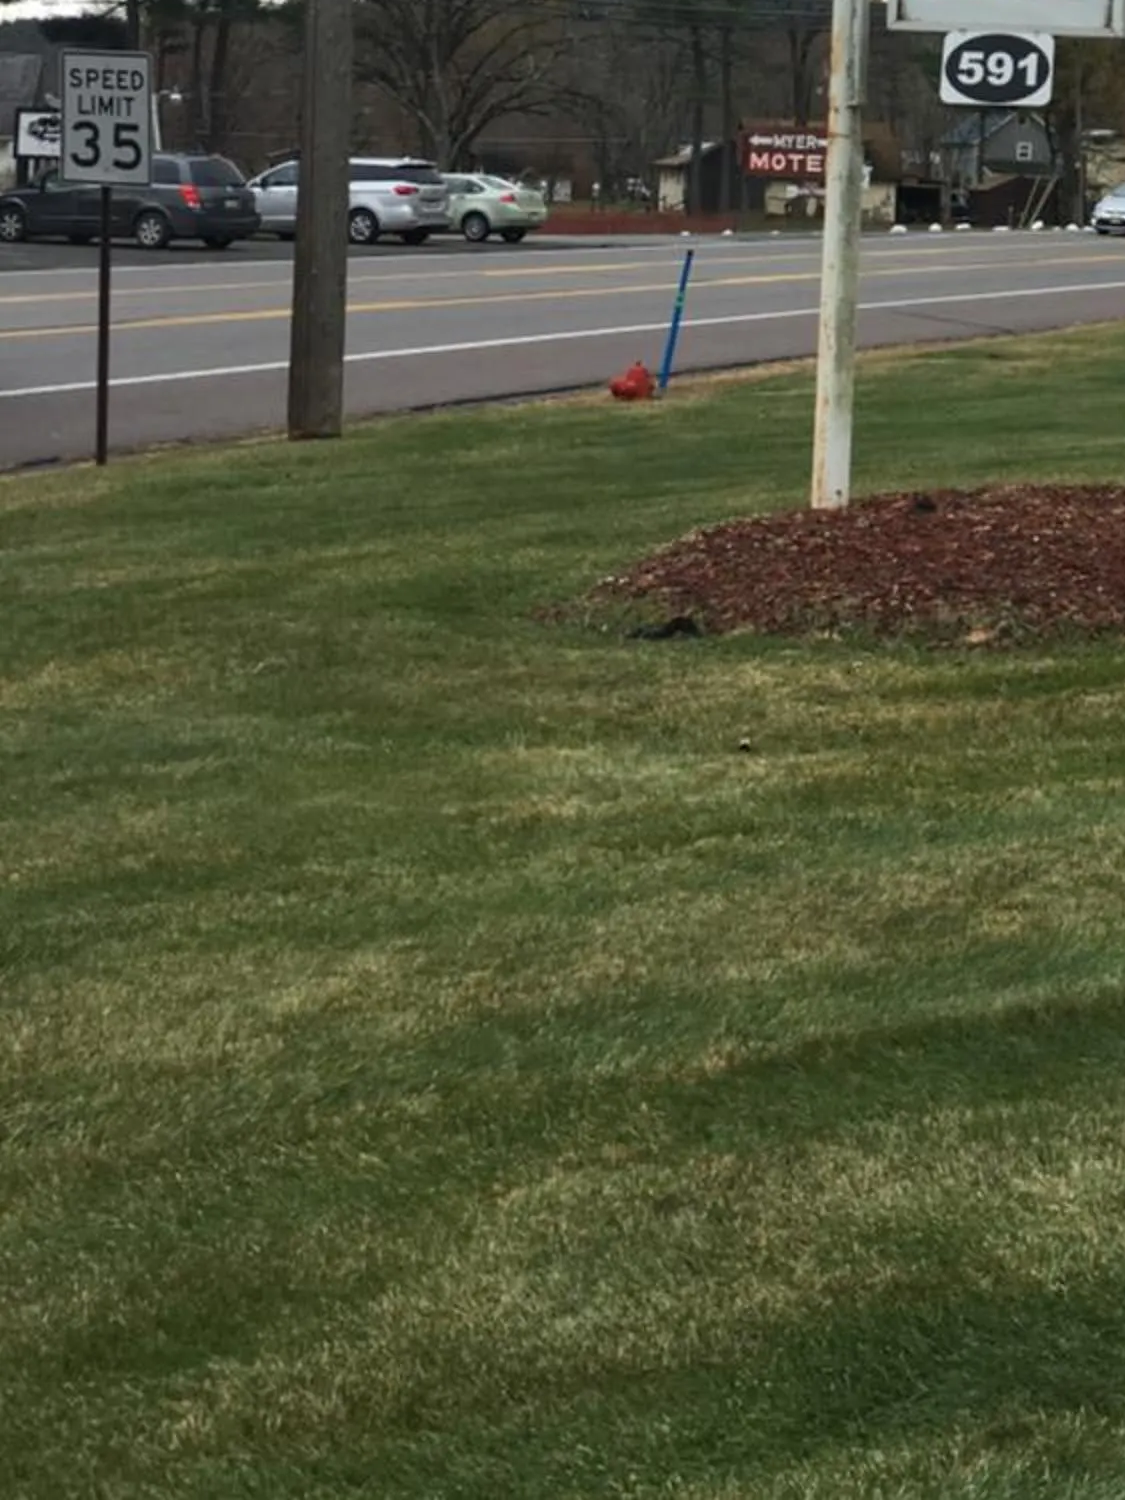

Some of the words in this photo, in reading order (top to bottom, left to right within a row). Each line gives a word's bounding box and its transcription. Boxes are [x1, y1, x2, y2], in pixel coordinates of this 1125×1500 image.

[69, 67, 145, 91] SPEED
[956, 50, 1040, 87] 591
[77, 94, 136, 116] LIMIT
[70, 120, 142, 171] 35
[749, 151, 824, 173] MOTE
